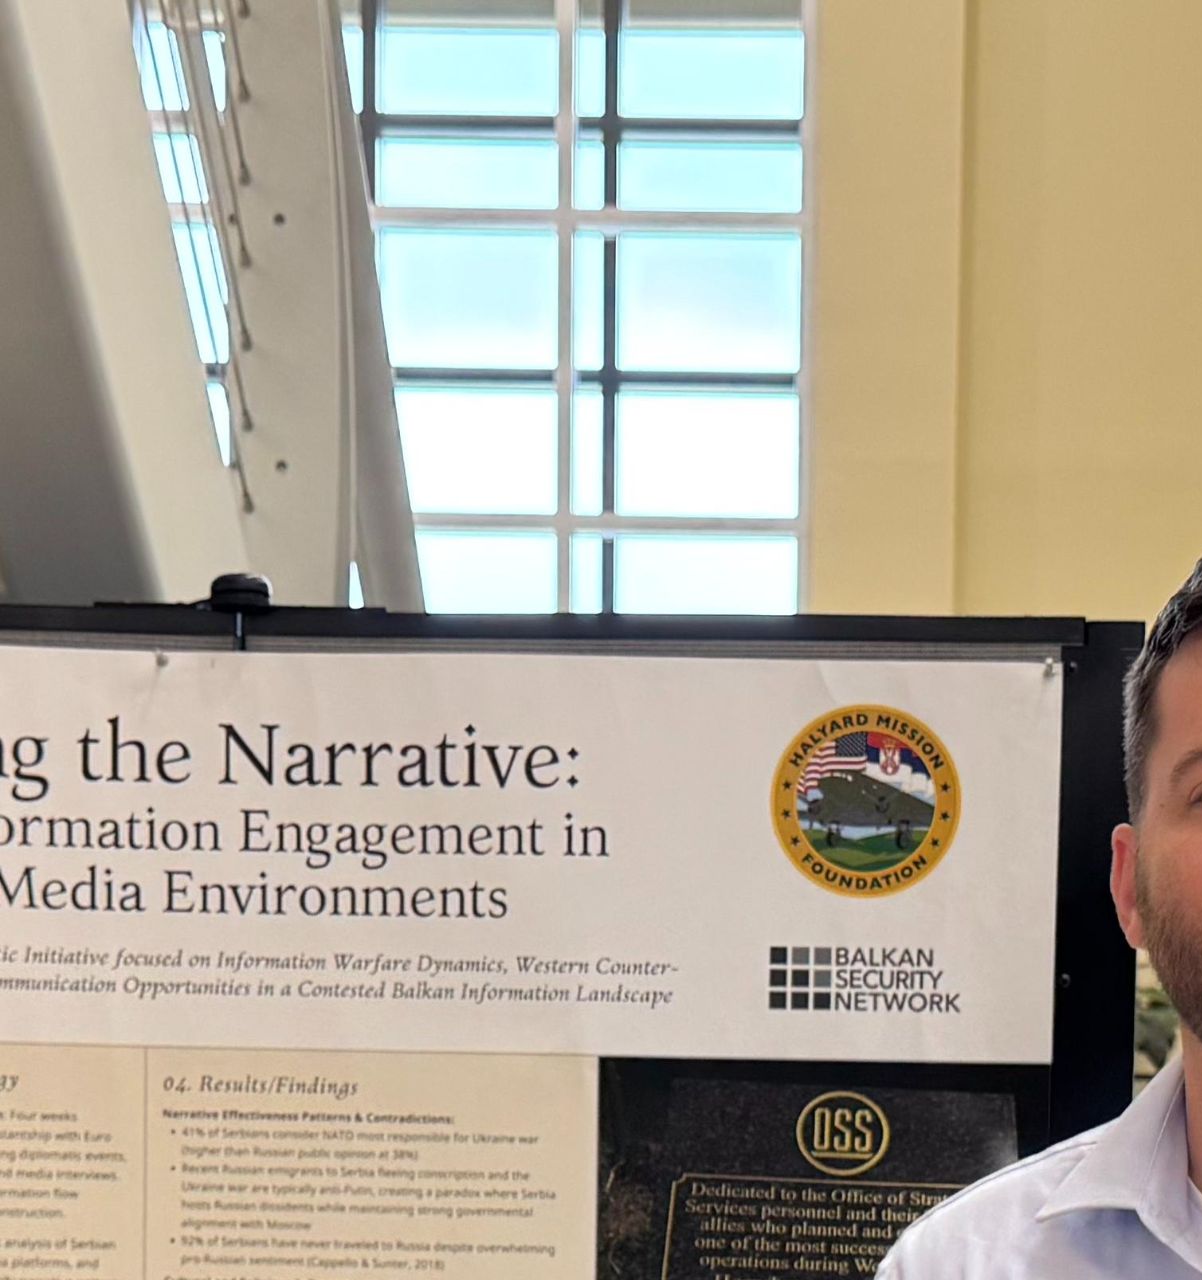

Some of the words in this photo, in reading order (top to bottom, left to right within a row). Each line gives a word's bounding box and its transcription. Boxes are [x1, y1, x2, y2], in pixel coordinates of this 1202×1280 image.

[77, 715, 191, 784] the
[218, 723, 579, 789] Narrative:
[789, 714, 868, 767] HALYARD
[876, 714, 944, 769] MISSION
[239, 808, 544, 870] Engagement
[563, 812, 609, 857] in
[802, 853, 928, 890] FOUNDATION
[0, 864, 146, 912] Media
[163, 869, 507, 919] Environments
[23, 945, 109, 966] Initiative
[111, 947, 183, 970] focused
[188, 954, 211, 968] on
[216, 950, 326, 973] Information
[333, 952, 412, 976] Warfare
[416, 953, 508, 978] Dynamics,
[516, 955, 589, 974] Western
[595, 956, 678, 976] Counter-
[835, 948, 934, 967] BALKAN
[835, 969, 943, 989] SECURITY
[122, 975, 251, 1000] Opportunities
[256, 979, 274, 997] in
[279, 983, 291, 997] a
[297, 979, 386, 999] Contested
[391, 980, 455, 1000] Balkan
[460, 981, 570, 1005] Information
[575, 983, 673, 1010] Landscape
[835, 993, 960, 1013] NETWORK
[162, 1075, 191, 1094] 04.
[199, 1073, 358, 1101] Results/Findings
[162, 1108, 219, 1120] Narrative
[221, 1109, 299, 1122] Effectiveness
[301, 1110, 352, 1123] Patterns
[365, 1111, 454, 1125] Contradictions:
[813, 1107, 873, 1152] OSS
[691, 1182, 775, 1200] Dedicated
[780, 1188, 797, 1200] to
[801, 1187, 826, 1202] the
[831, 1188, 883, 1204] Office
[887, 1190, 906, 1205] of
[685, 1198, 756, 1216] Services
[761, 1201, 841, 1220] personnel
[846, 1206, 876, 1221] and
[881, 1207, 919, 1222] their
[700, 1216, 745, 1232] allies
[751, 1219, 787, 1234] who
[791, 1220, 858, 1239] planned
[862, 1224, 893, 1239] and
[694, 1237, 726, 1249] one
[730, 1235, 752, 1251] of
[754, 1236, 780, 1252] the
[785, 1241, 826, 1254] most
[699, 1253, 789, 1271] operations
[793, 1255, 849, 1275] during
